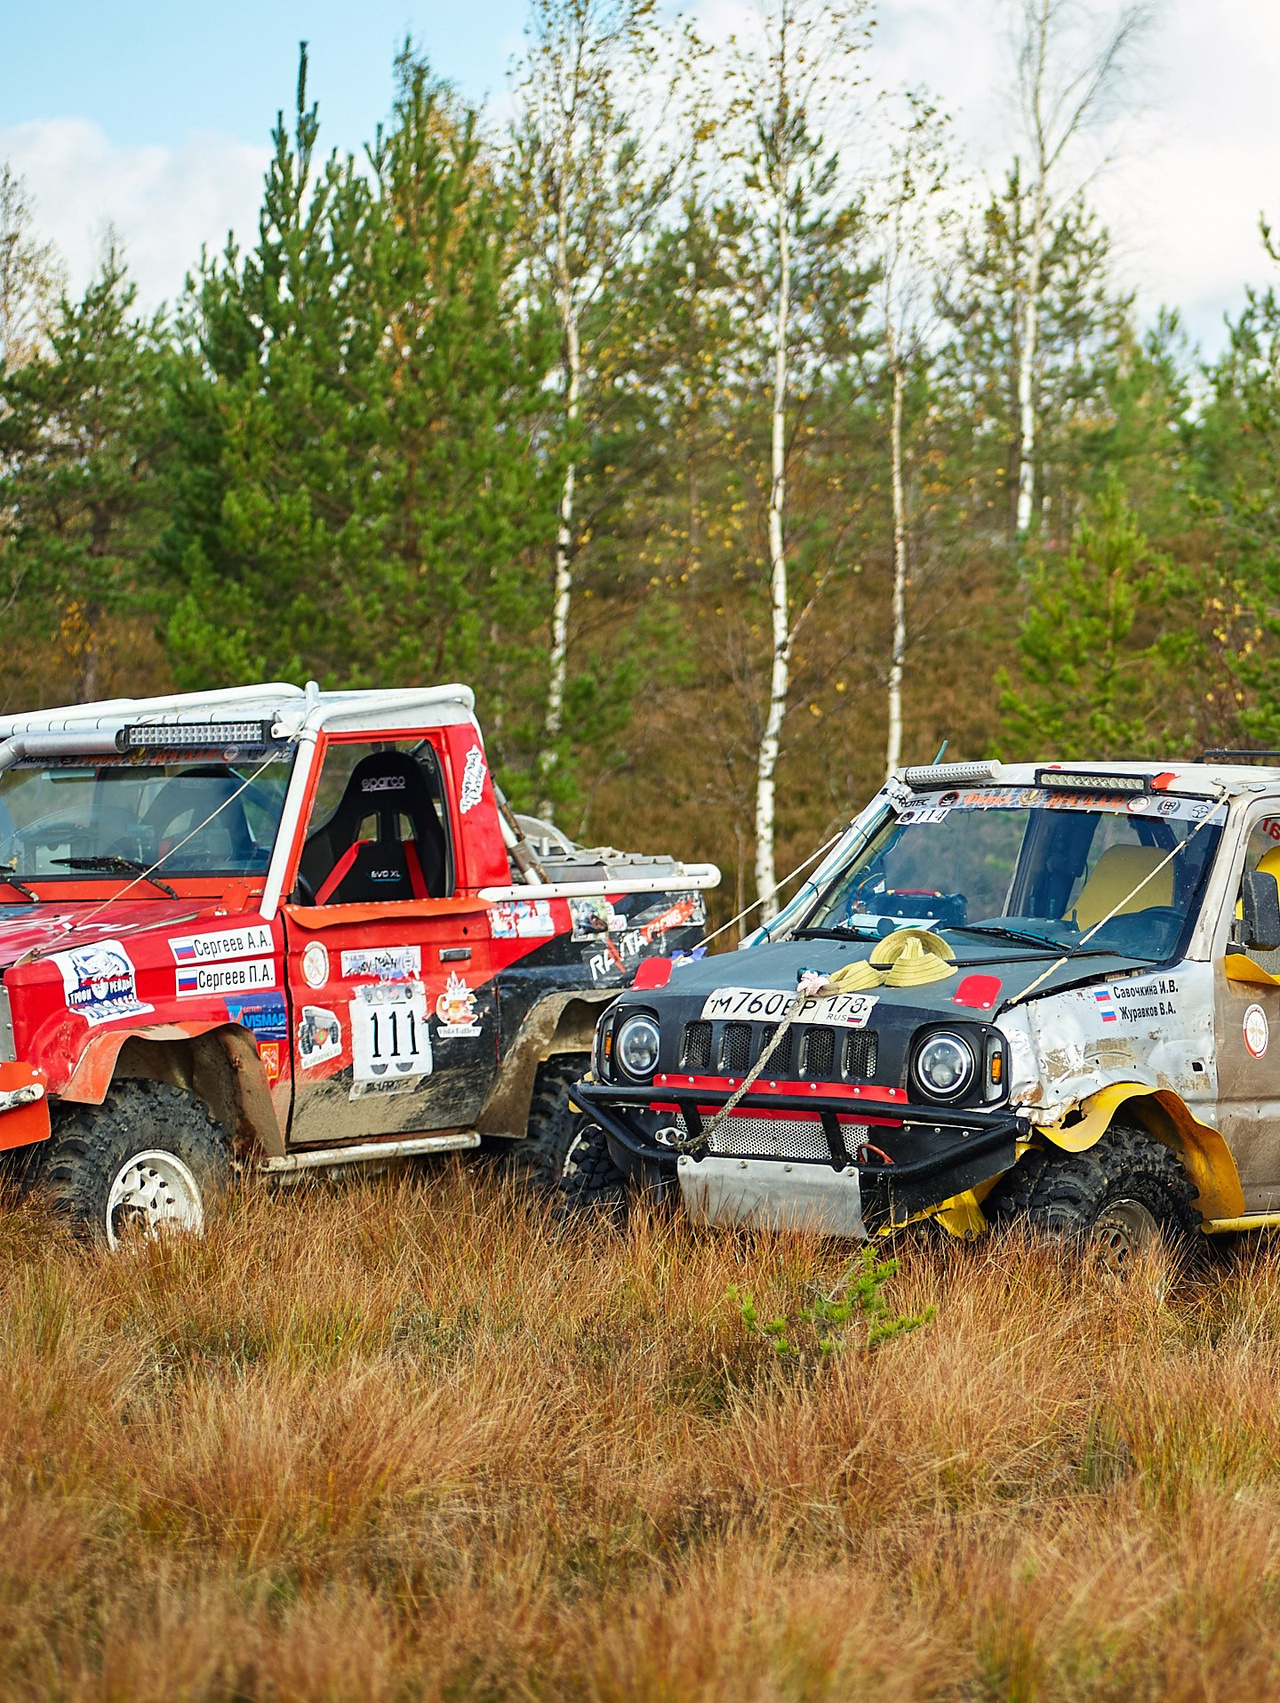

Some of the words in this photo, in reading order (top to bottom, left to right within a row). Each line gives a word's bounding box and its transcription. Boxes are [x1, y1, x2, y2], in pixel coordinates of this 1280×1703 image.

[1044, 793, 1125, 809] ДОСААФ
[916, 809, 946, 822] 114
[194, 936, 244, 958] Сергеев
[248, 930, 272, 950] А.А.
[198, 970, 246, 990] Сергеев
[249, 964, 273, 983] П.А.
[1113, 984, 1158, 999] Савочкина
[1159, 979, 1179, 994] И.В.
[826, 1013, 847, 1022] RUS
[1119, 1005, 1158, 1022] Журавков
[1159, 1001, 1176, 1015] В.А.
[370, 1010, 420, 1058] 111
